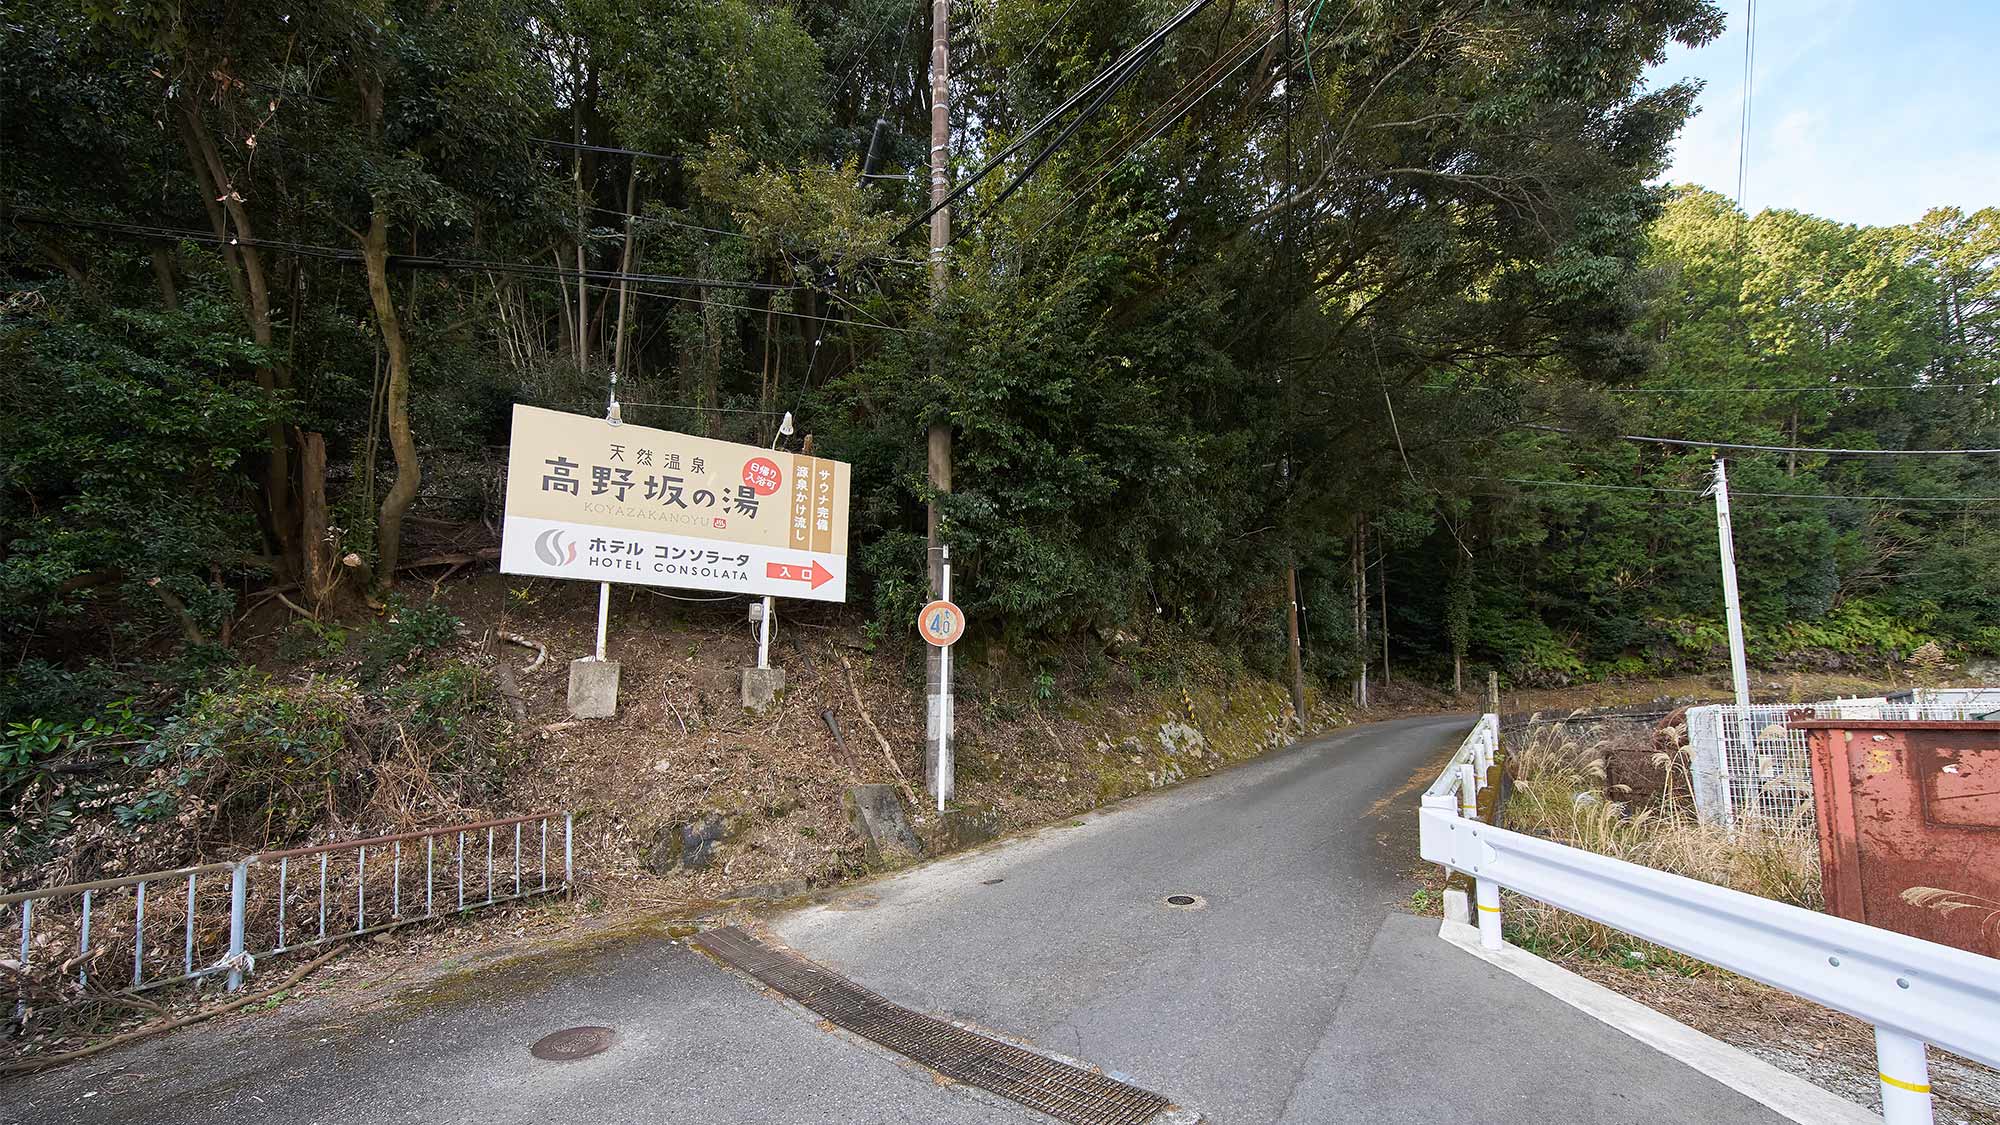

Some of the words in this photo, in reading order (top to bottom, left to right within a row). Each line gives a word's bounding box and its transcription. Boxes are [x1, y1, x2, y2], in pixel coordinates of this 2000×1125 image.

[609, 443, 705, 475] 天然温泉
[750, 462, 777, 480] 日帰り
[541, 456, 760, 520] 高野坂の湯
[744, 471, 778, 491] 入浴可
[583, 501, 710, 527] KOYAZAKANOYU
[793, 465, 809, 542] 源泉かけ流し
[815, 469, 831, 532] サウナ完備
[588, 537, 645, 557] ホテル
[654, 545, 750, 568] コンソラータ
[588, 556, 643, 571] HOTEL
[653, 562, 749, 582] CONSOLATA
[779, 566, 812, 580] 入口
